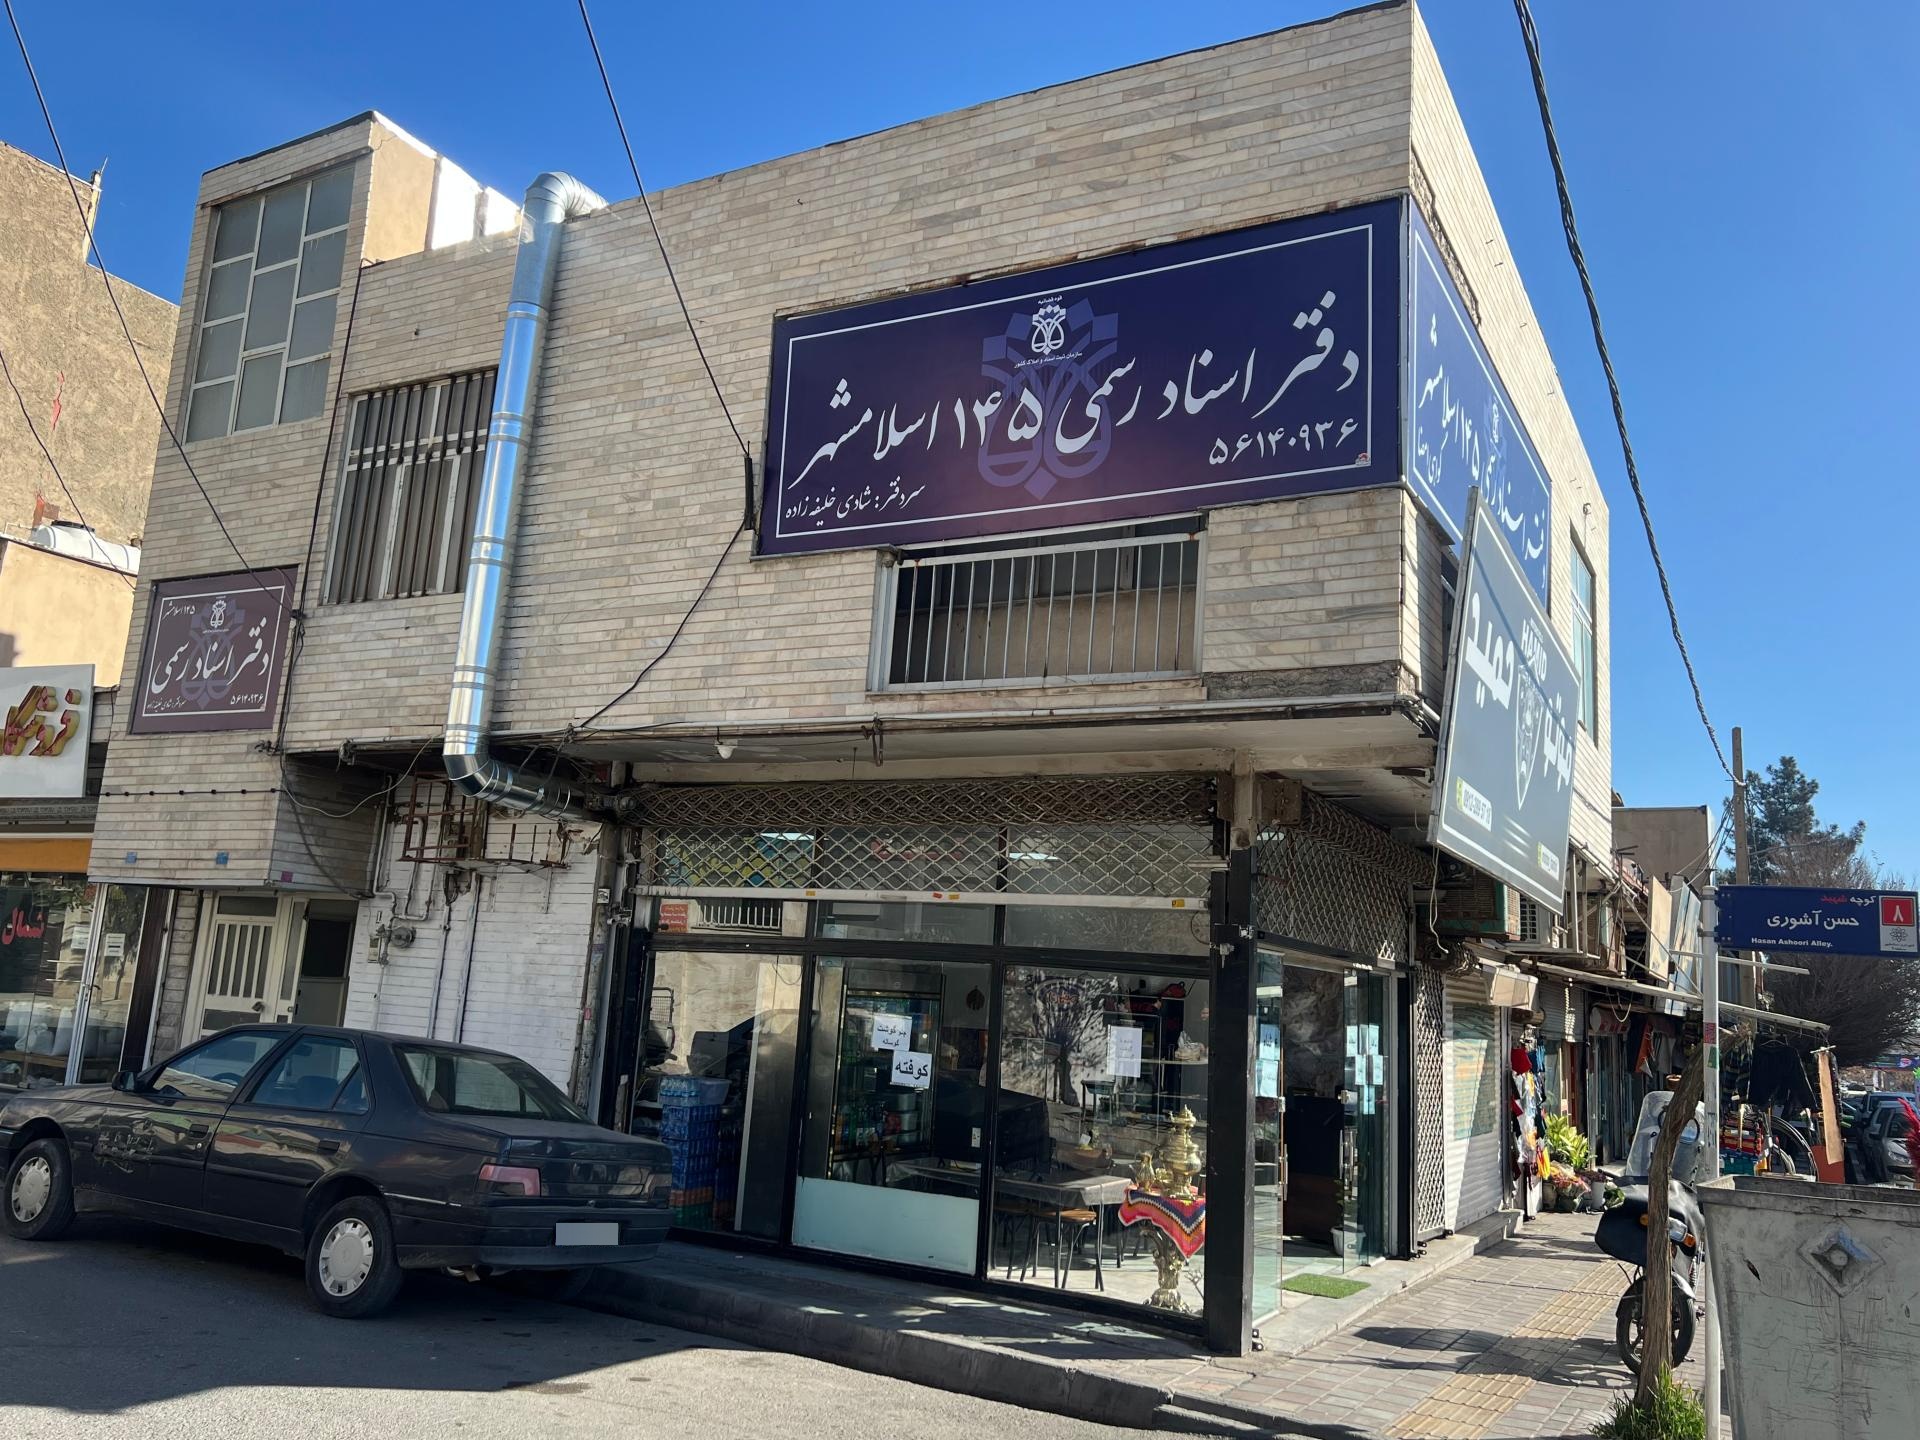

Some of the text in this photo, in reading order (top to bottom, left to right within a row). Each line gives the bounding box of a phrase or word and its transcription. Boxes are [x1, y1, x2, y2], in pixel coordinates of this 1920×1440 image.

[787, 290, 1360, 490] دفتر اسناد رسمی ۱۴۵ اسلامشهر
[1418, 313, 1460, 444] اسلامشهر
[1208, 417, 1359, 465] ۵۶۱۴۰۹۳۶
[1461, 406, 1480, 481] ۱۴۵
[808, 486, 836, 526] خلیفه
[836, 485, 872, 519] شادی
[151, 616, 270, 694] دفتر اسناد رسمی
[1465, 592, 1515, 710] حمید
[1521, 617, 1548, 682] HAMID
[1767, 909, 1860, 930] حسن آشوری
[1849, 895, 1877, 906] کوچه
[1892, 904, 1904, 922] ۸
[1751, 937, 1833, 948] Hasan Ashoori Alley.
[895, 1059, 928, 1080] کوفته
